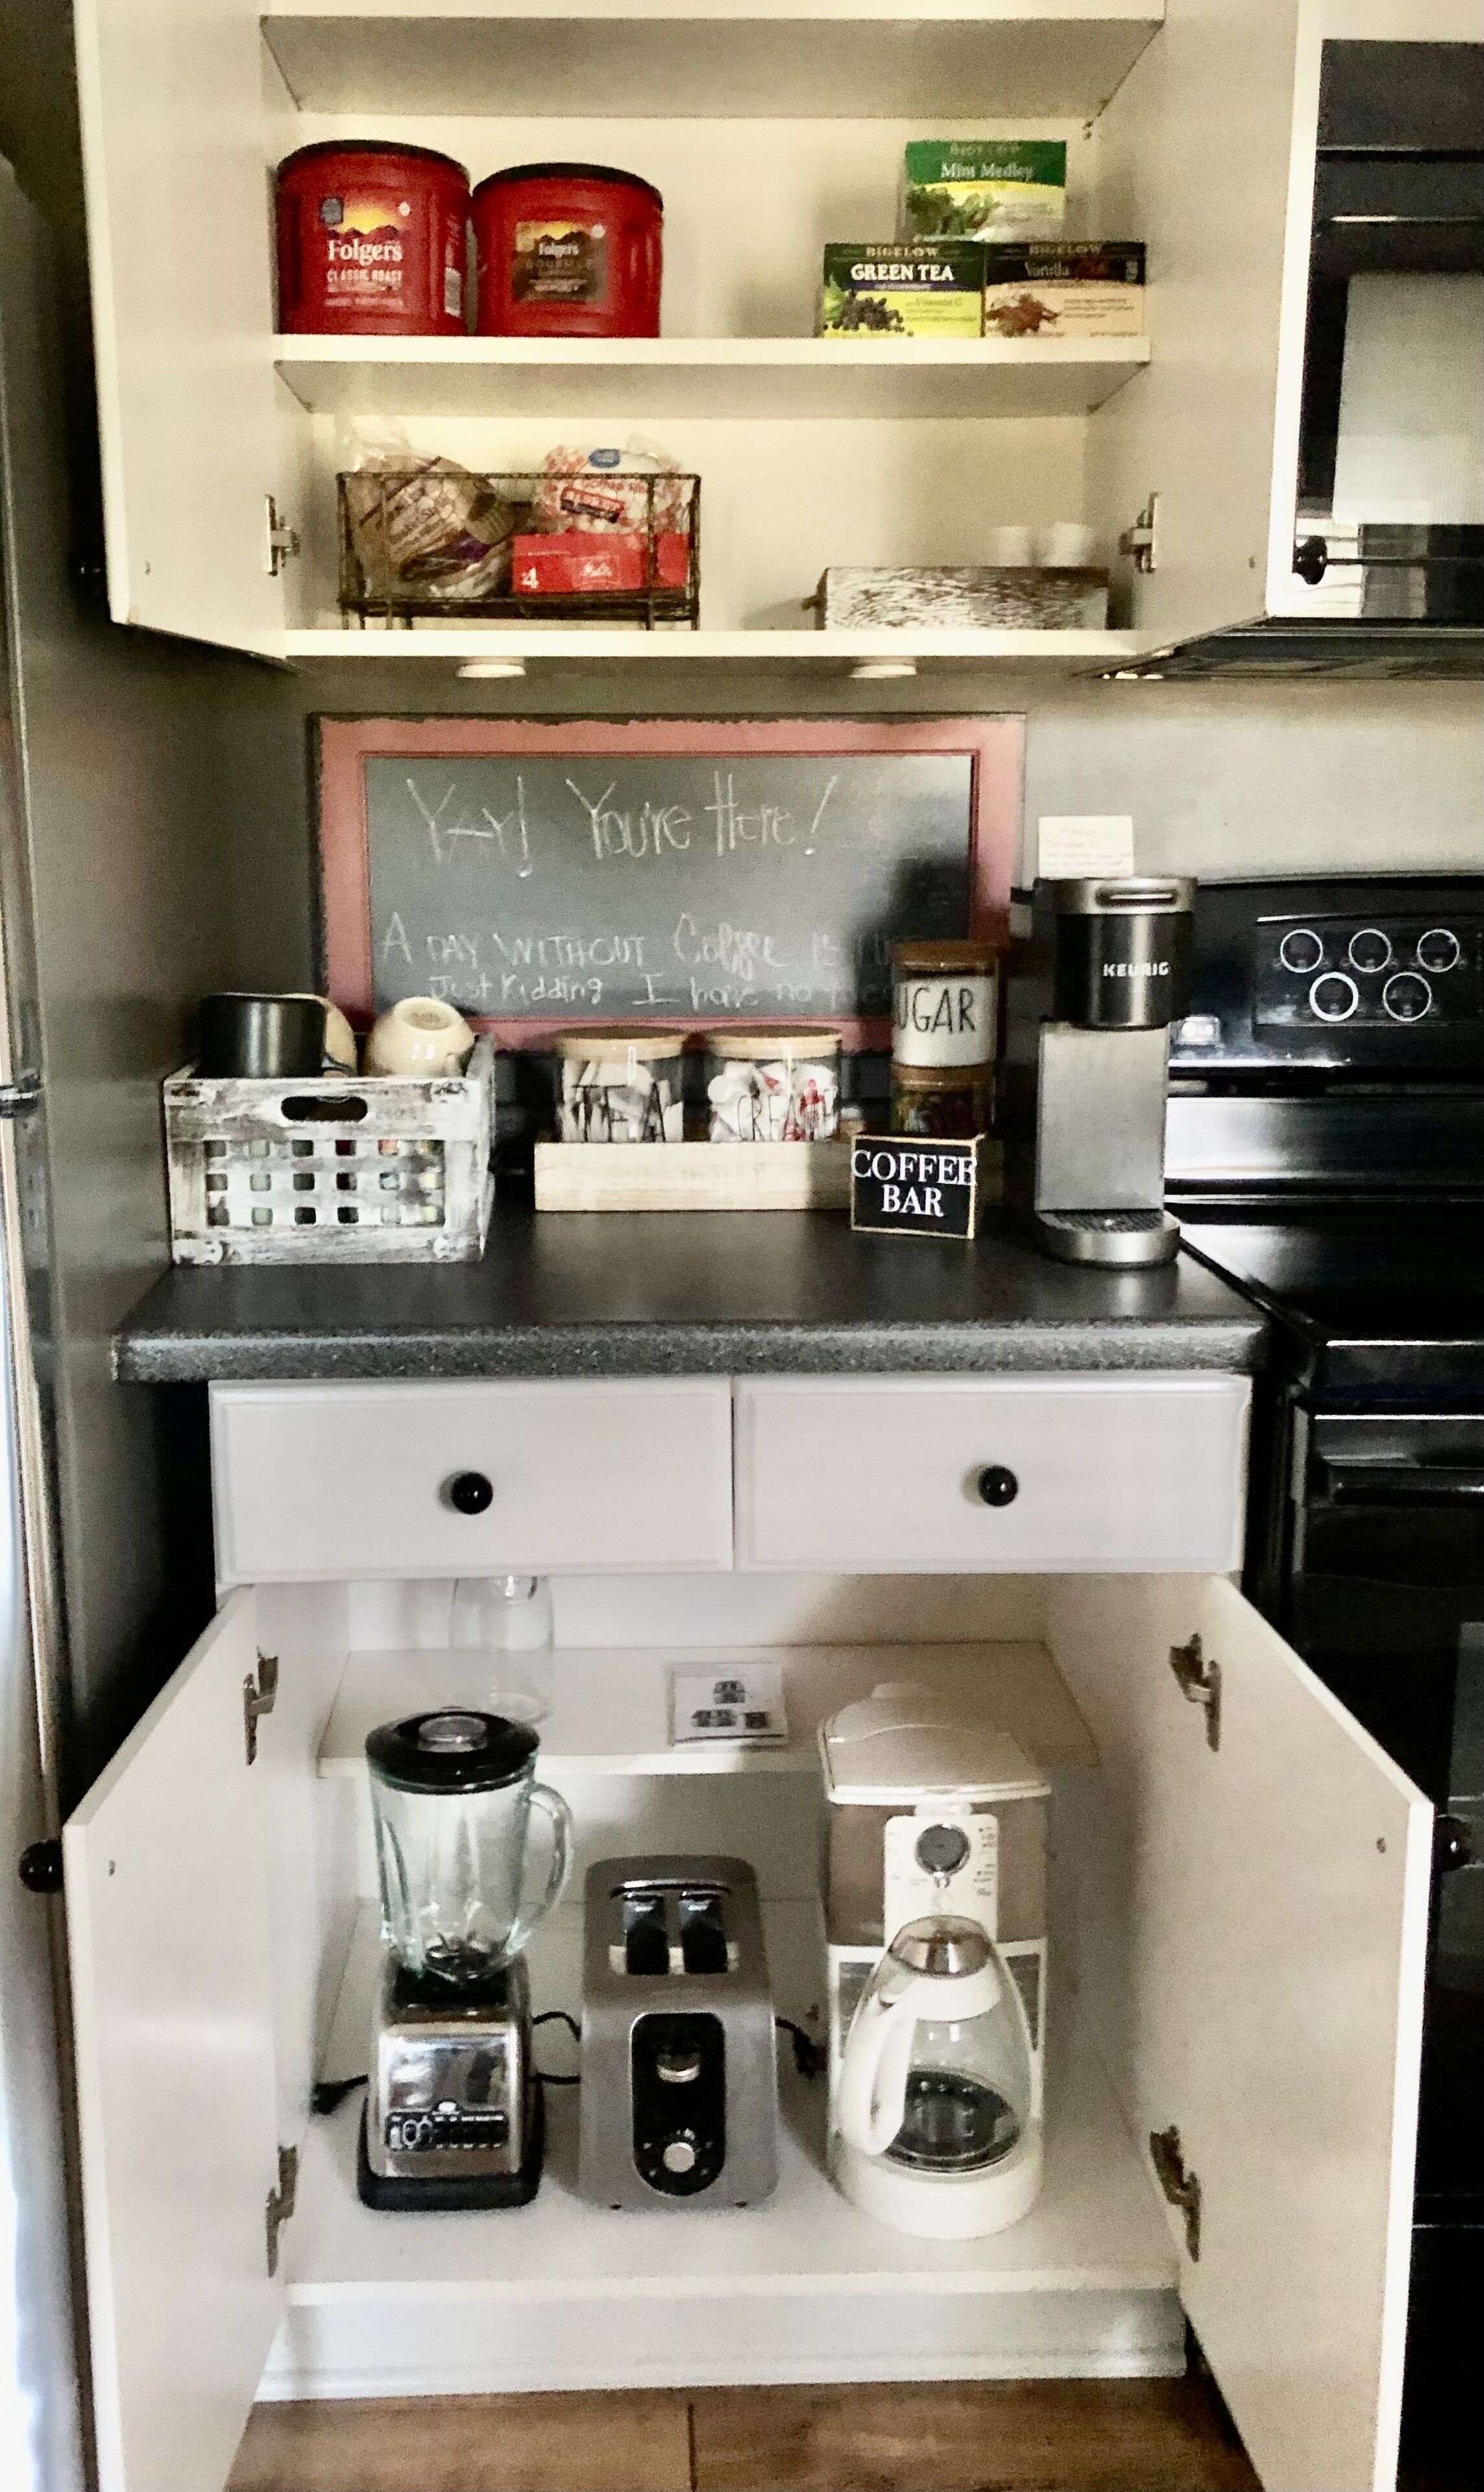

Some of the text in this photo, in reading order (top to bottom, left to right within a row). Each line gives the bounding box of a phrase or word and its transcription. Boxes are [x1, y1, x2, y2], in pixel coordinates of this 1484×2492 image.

[328, 238, 403, 267] Folgers
[851, 263, 955, 281] GREEN TEA
[383, 912, 412, 965] A
[1102, 961, 1169, 977] KEURIG
[896, 986, 975, 1034] UGAR
[851, 1149, 977, 1186] COFFEE
[881, 1183, 945, 1217] BAR
